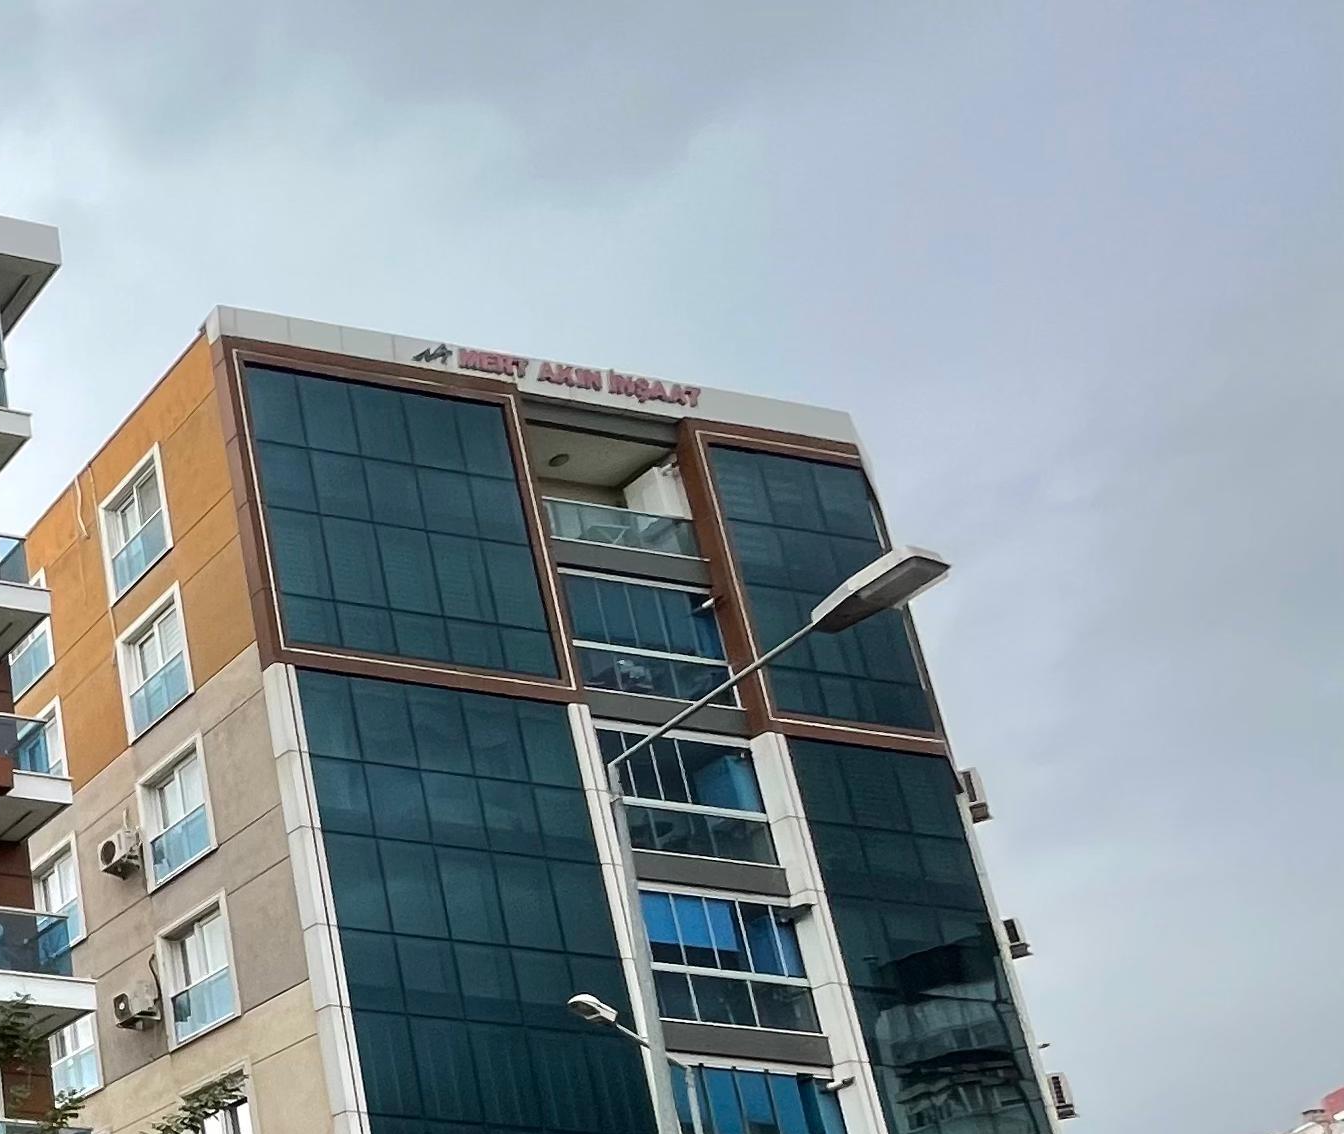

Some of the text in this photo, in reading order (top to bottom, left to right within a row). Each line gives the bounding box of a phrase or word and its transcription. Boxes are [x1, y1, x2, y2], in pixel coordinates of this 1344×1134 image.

[457, 348, 702, 408] MERT AKIN İNŞAAT
